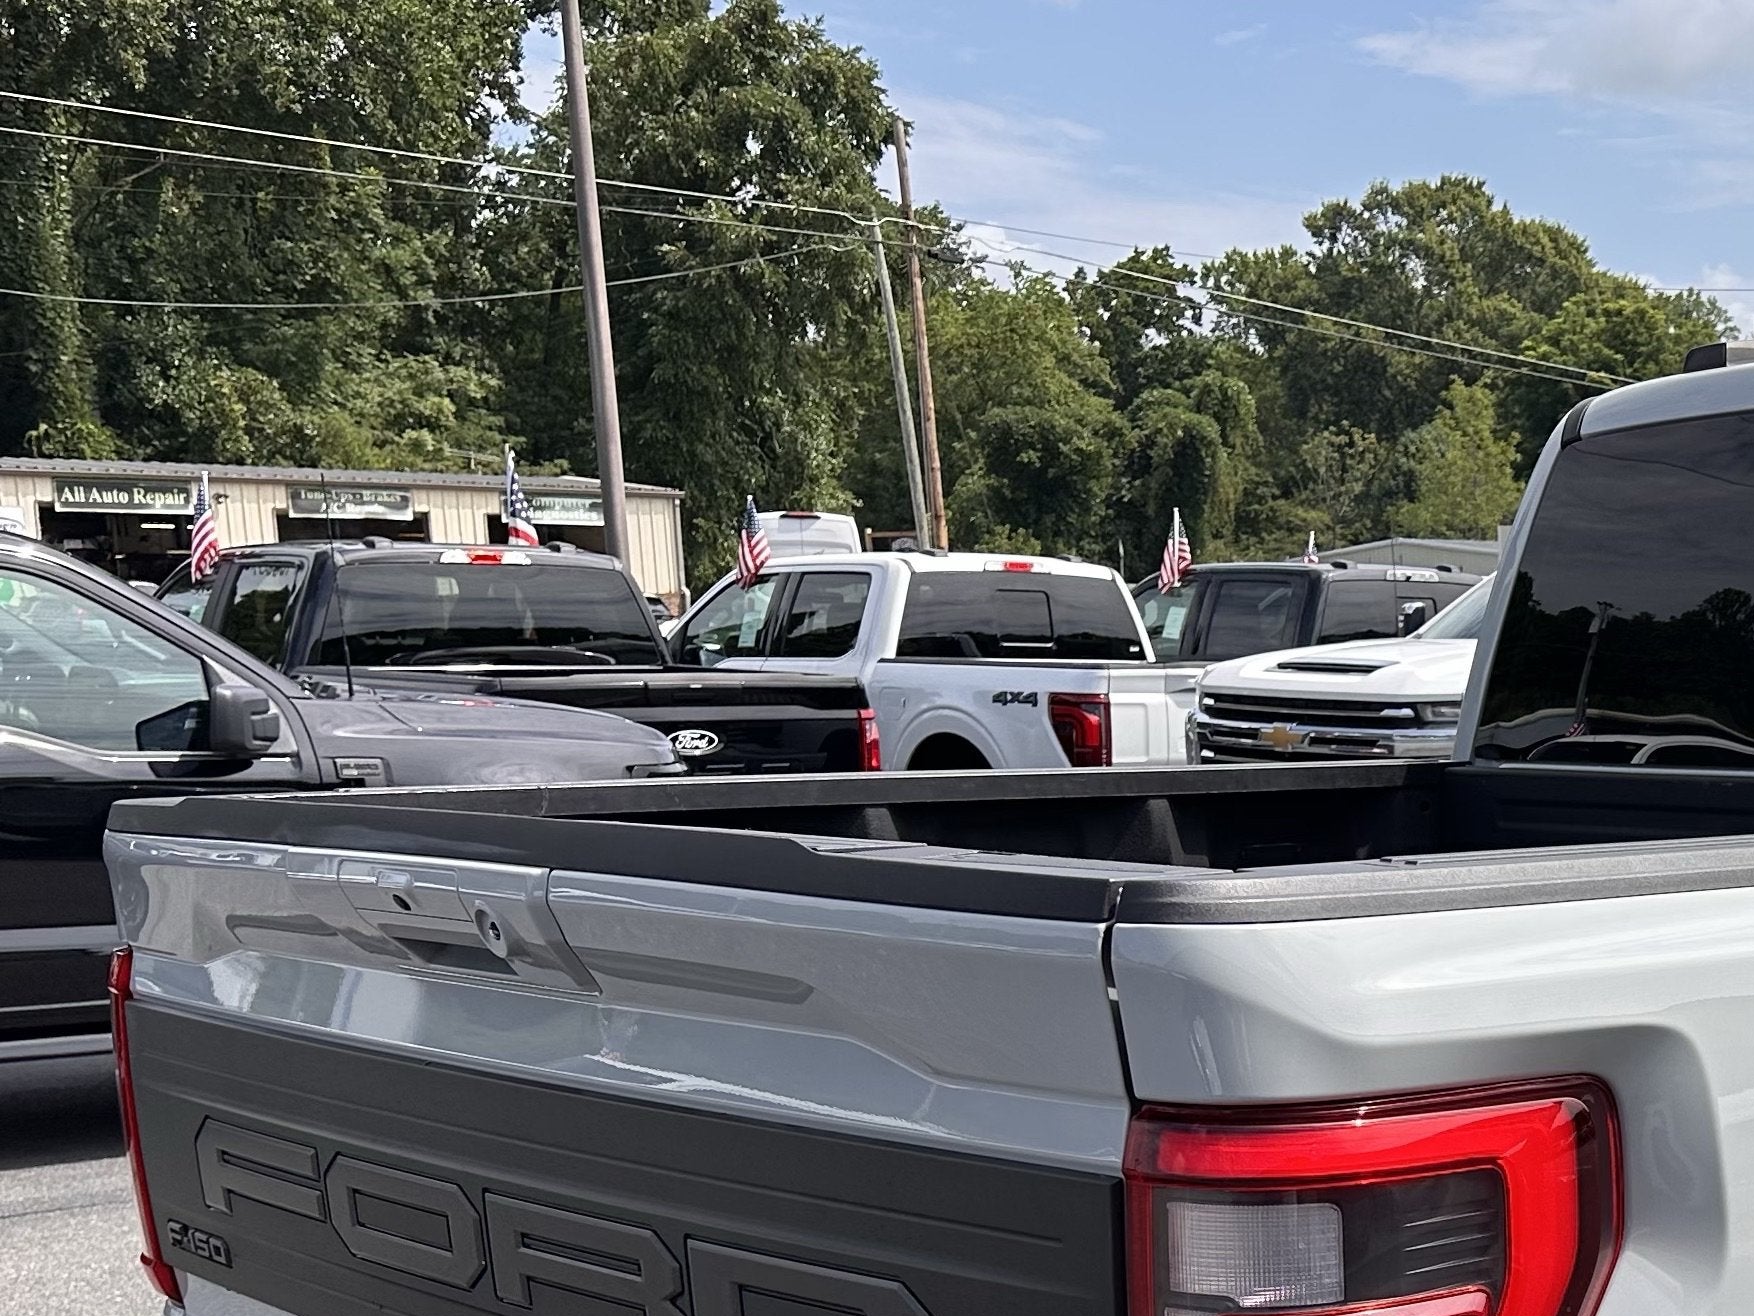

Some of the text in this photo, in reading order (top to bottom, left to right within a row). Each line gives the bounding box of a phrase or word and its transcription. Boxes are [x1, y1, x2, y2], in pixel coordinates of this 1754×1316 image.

[60, 486, 188, 508] All Auto Repair
[527, 507, 599, 521] iagnostics
[166, 1218, 231, 1268] F-150
